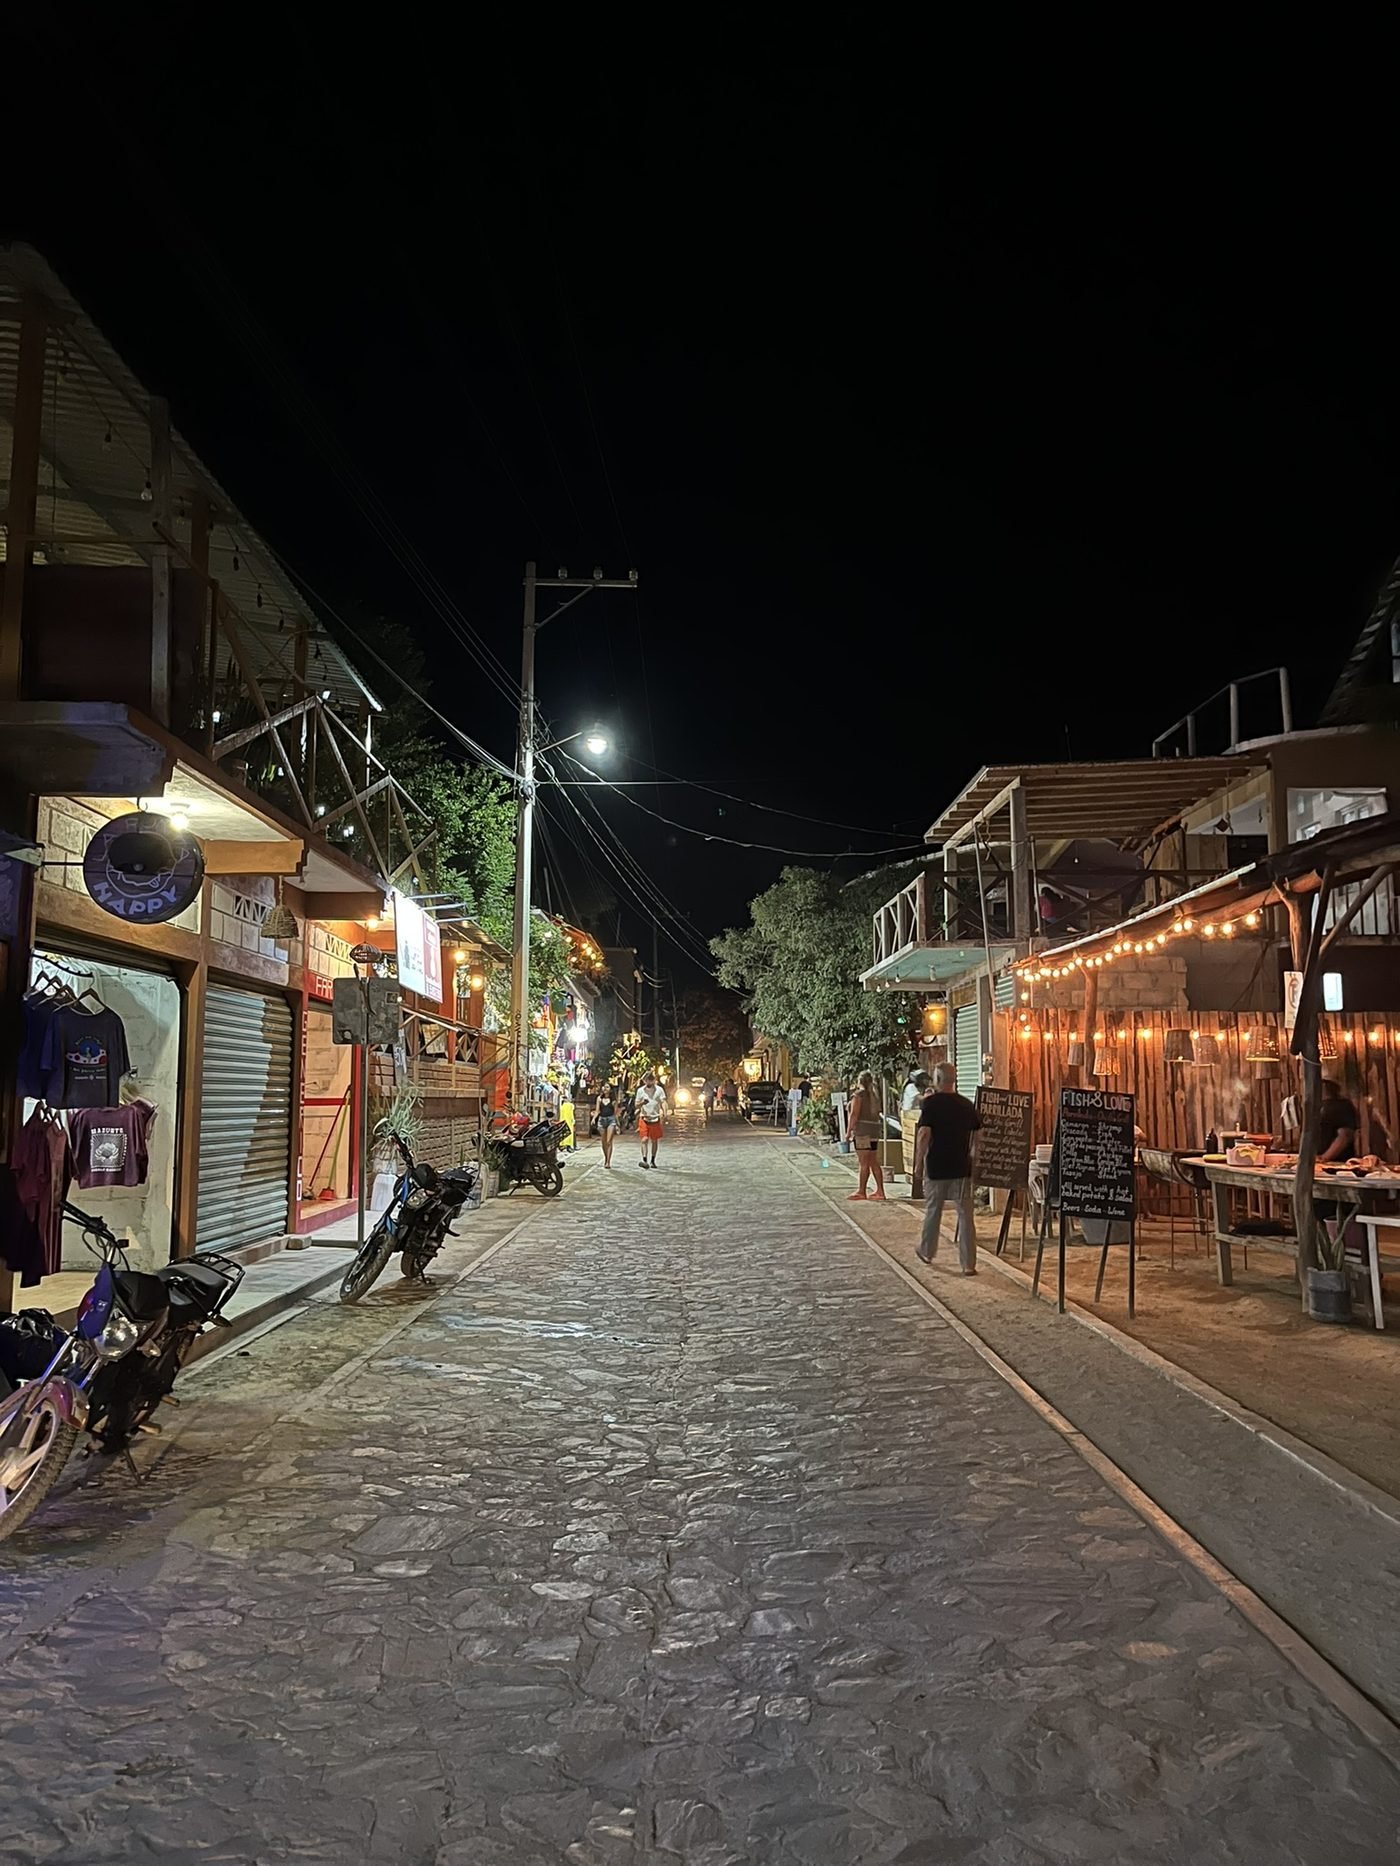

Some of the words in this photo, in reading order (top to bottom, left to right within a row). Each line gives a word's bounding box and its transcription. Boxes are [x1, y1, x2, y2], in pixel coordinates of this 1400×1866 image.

[93, 882, 177, 915] HAPPY
[982, 1091, 1000, 1104] FISH
[1009, 1094, 1030, 1107] LOVE
[1063, 1091, 1090, 1107] FISH
[1090, 1091, 1103, 1108] &
[1104, 1095, 1132, 1112] LOVE
[1062, 1201, 1080, 1212] Beers
[1084, 1204, 1102, 1214] Soda
